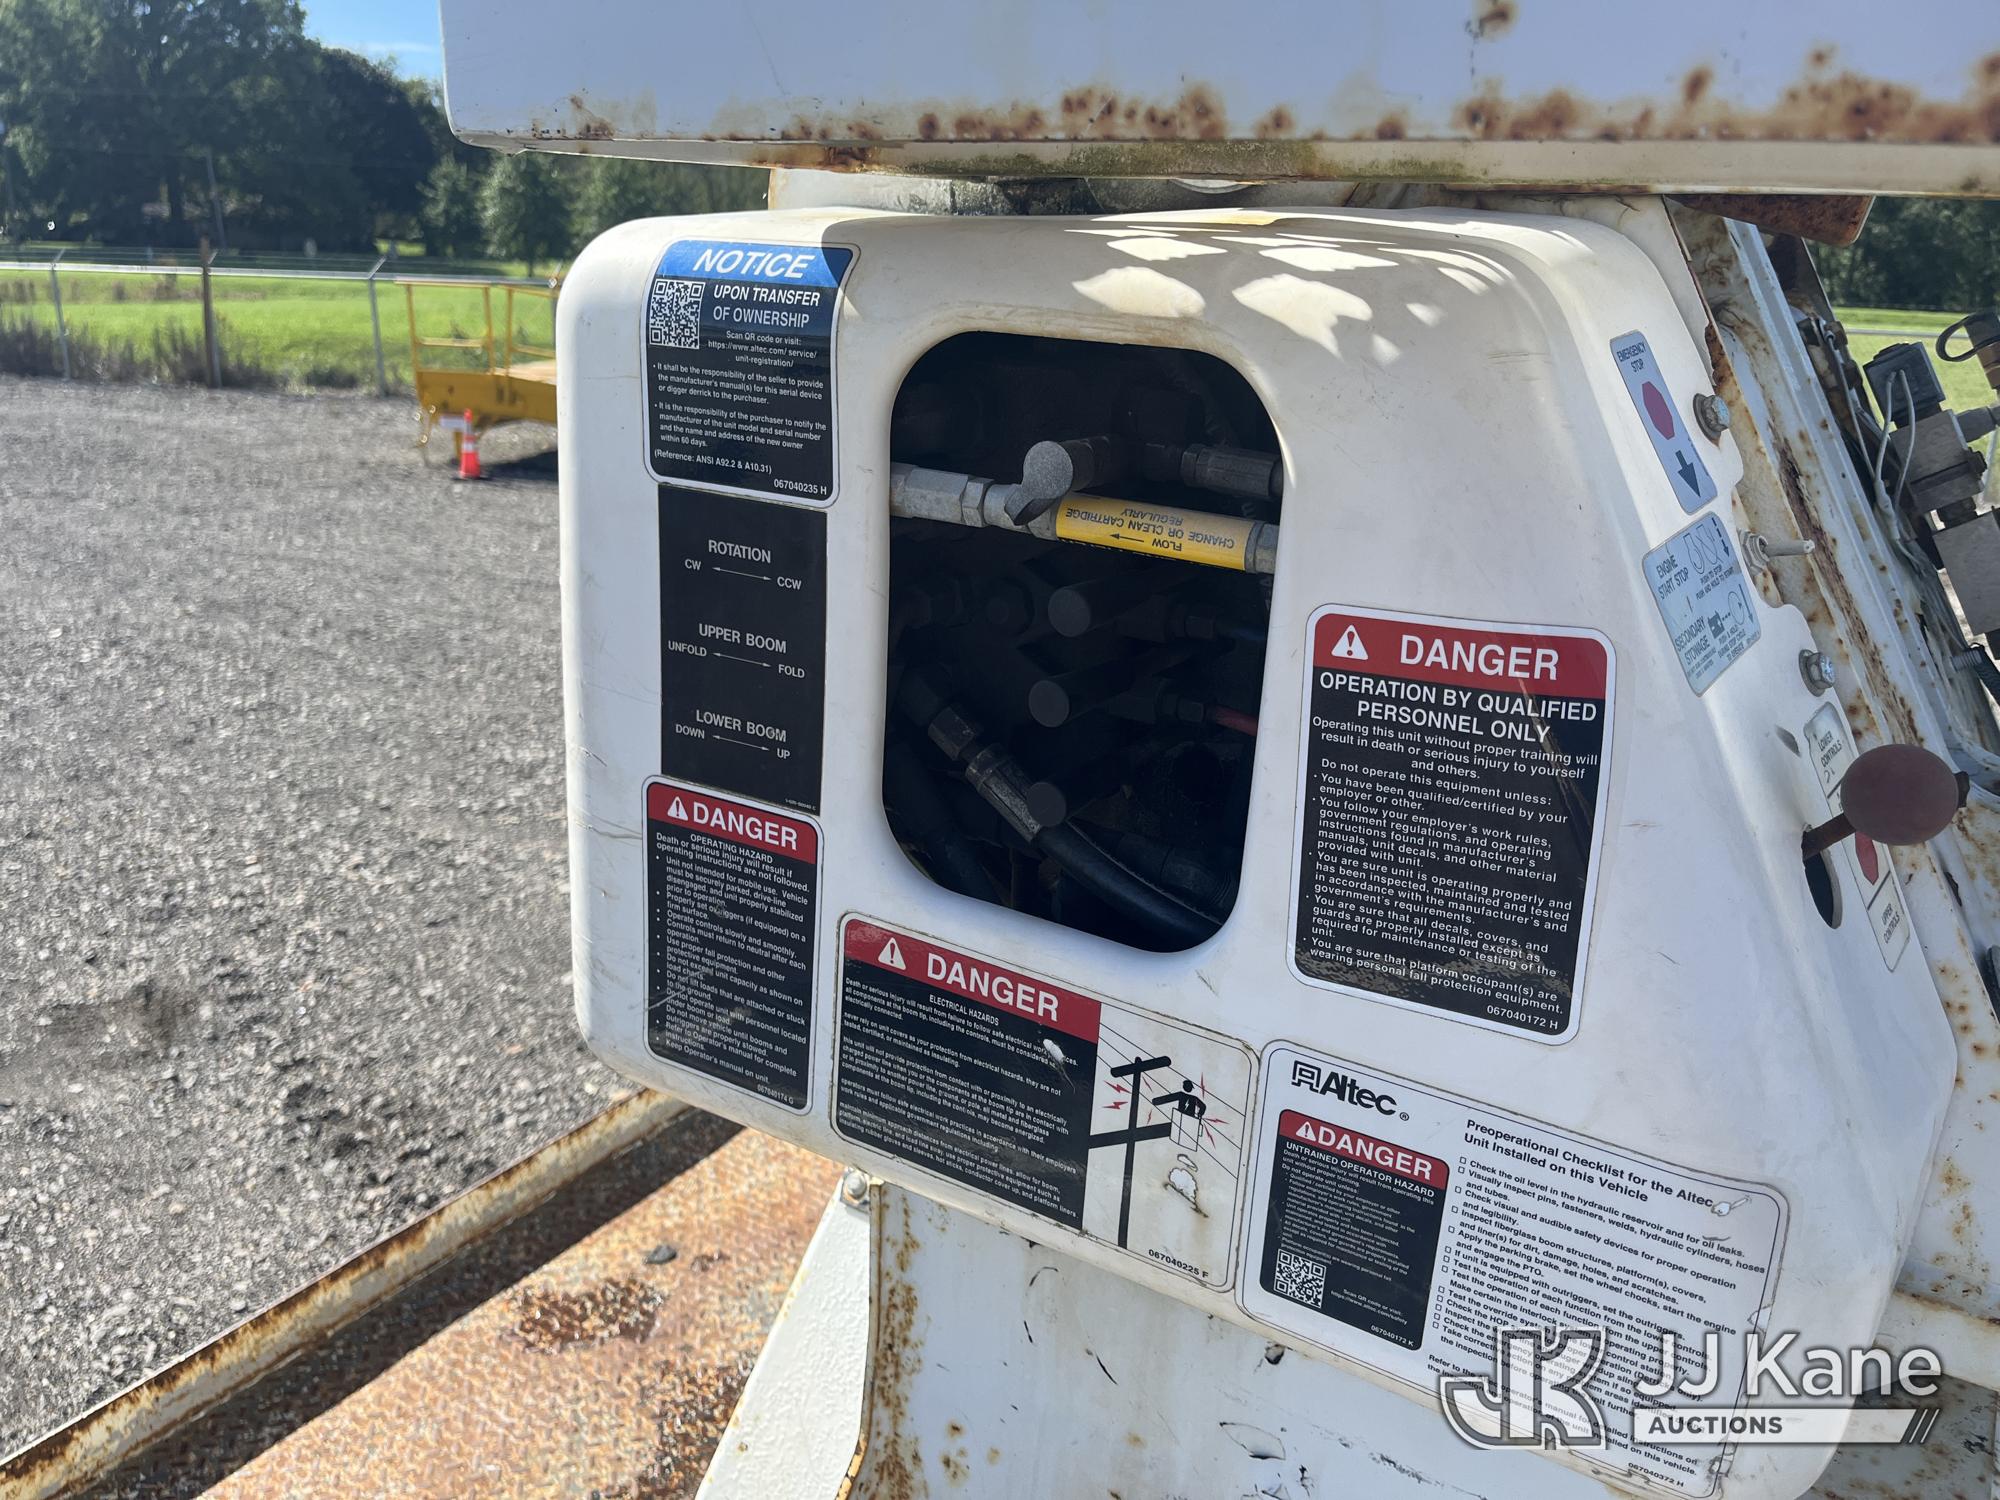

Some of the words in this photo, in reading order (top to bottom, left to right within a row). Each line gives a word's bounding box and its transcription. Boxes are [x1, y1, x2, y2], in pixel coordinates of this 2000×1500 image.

[693, 248, 815, 279] NOTICE
[713, 284, 748, 301] UPON
[752, 287, 821, 307] TRANSFER
[713, 305, 731, 321] OF
[733, 307, 810, 329] OWNERSHIP
[726, 330, 743, 339] Scan
[744, 331, 755, 341] QR
[756, 334, 774, 343] code
[774, 336, 783, 344] or
[1616, 342, 1646, 363] EMERGENCY
[657, 362, 662, 370] It
[663, 363, 679, 371] shall
[679, 364, 688, 373] be
[689, 365, 700, 374] the
[701, 368, 746, 381] responsibility
[747, 372, 754, 380] of
[755, 373, 767, 382] the
[768, 375, 787, 384] seller
[788, 377, 796, 385] to
[796, 379, 823, 389] provide
[1630, 359, 1644, 373] STOP
[654, 448, 694, 462] (Reference:
[695, 454, 714, 464] ANSI
[715, 457, 736, 468] A92.2
[736, 460, 743, 469] &
[744, 461, 772, 475] A10.31)
[773, 478, 818, 494] 067040235
[820, 485, 827, 495] H
[1065, 508, 1124, 527] CARTRIDGE
[1121, 508, 1184, 526] REGULARLY
[1127, 520, 1164, 535] CLEAN
[1151, 538, 1183, 552] FLOW
[1168, 528, 1184, 538] OR
[1187, 532, 1235, 549] CHANGE
[708, 539, 771, 564] ROTATION
[1655, 554, 1678, 579] ENGINE
[685, 559, 701, 571] CW
[777, 576, 802, 590] CCW
[1658, 576, 1675, 600] START
[1676, 567, 1689, 587] STOP
[699, 623, 741, 644] UPPER
[746, 632, 787, 654] BOOM
[1674, 615, 1706, 652] SECONDARY
[668, 640, 707, 657] UNFOLD
[778, 664, 805, 679] FOLD
[1400, 634, 1559, 681] DANGER
[1320, 671, 1437, 704] OPERATION
[1443, 691, 1472, 709] BY
[1477, 694, 1597, 722] QUALIFIED
[696, 709, 742, 732] LOWER
[746, 721, 787, 742] BOOM
[1357, 700, 1484, 736] PERSONNEL
[1490, 720, 1550, 743] ONLY
[675, 724, 705, 739] DOWN
[777, 748, 791, 760] UP
[1312, 715, 1369, 736] Operating
[1371, 725, 1394, 738] this
[1397, 731, 1421, 742] unit
[1424, 734, 1470, 750] without
[1473, 743, 1517, 757] proper
[1520, 746, 1571, 764] training
[1575, 753, 1600, 768] will
[1321, 732, 1354, 745] result
[1356, 735, 1368, 747] in
[1371, 738, 1404, 753] death
[1407, 746, 1421, 755] or
[1423, 748, 1470, 764] serious
[1473, 754, 1510, 771] injury
[1513, 760, 1526, 772] to
[1530, 765, 1585, 779] yourself
[1321, 757, 1337, 769] Do
[1340, 763, 1358, 773] not
[1361, 766, 1406, 781] operate
[1409, 773, 1432, 785] this
[1435, 779, 1500, 798] equipment
[1504, 791, 1551, 805] unless:
[1410, 760, 1434, 771] and
[1437, 763, 1480, 779] others.
[1319, 785, 1372, 801] employer
[1375, 795, 1388, 804] or
[1390, 797, 1424, 810] other.
[1321, 772, 1341, 784] You
[1345, 776, 1372, 790] have
[1375, 782, 1404, 796] been
[1407, 789, 1515, 815] qualified/certified
[1518, 807, 1534, 819] by
[1538, 812, 1568, 823] your
[693, 801, 798, 851] DANGER
[656, 831, 679, 845] Death
[680, 840, 689, 848] or
[690, 842, 720, 857] serious
[721, 849, 744, 865] injury
[746, 858, 760, 868] will
[761, 863, 785, 876] result
[786, 868, 792, 878] if
[656, 842, 693, 860] operating
[695, 851, 742, 872] instructions
[743, 866, 756, 876] are
[758, 870, 771, 881] not
[690, 833, 737, 854] OPERATING
[739, 848, 773, 864] HAZARD
[927, 952, 1059, 1022] DANGER
[929, 994, 968, 1015] ELECTRICAL
[968, 1008, 999, 1026] HAZARDS
[1486, 1004, 1546, 1027] 067040172
[1549, 1019, 1558, 1030] H
[1320, 1071, 1397, 1116] Altec
[1318, 1125, 1433, 1181] DANGER
[1464, 1132, 1490, 1149] Unit
[1491, 1141, 1546, 1168] Installed
[1549, 1163, 1566, 1174] on
[1569, 1167, 1594, 1184] this
[1598, 1176, 1648, 1202] Vehicle
[1466, 1118, 1559, 1157] Preoperational
[1562, 1150, 1624, 1179] Checklist
[1627, 1171, 1648, 1186] for
[1650, 1179, 1673, 1195] the
[1675, 1188, 1714, 1208] Altec
[1286, 1141, 1339, 1165] UNTRAINED
[1340, 1160, 1392, 1183] OPERATOR
[1394, 1180, 1435, 1198] HAZARD
[1469, 1159, 1496, 1175] Check
[1498, 1169, 1512, 1180] the
[1513, 1176, 1525, 1184] oil
[1526, 1179, 1548, 1192] level
[1549, 1186, 1558, 1196] in
[1560, 1190, 1575, 1201] the
[1576, 1195, 1619, 1216] hydraulic
[1621, 1212, 1664, 1231] reservoir
[1665, 1228, 1684, 1239] and
[1685, 1233, 1700, 1244] for
[1701, 1239, 1717, 1249] oil
[1148, 1249, 1200, 1275] 067040225
